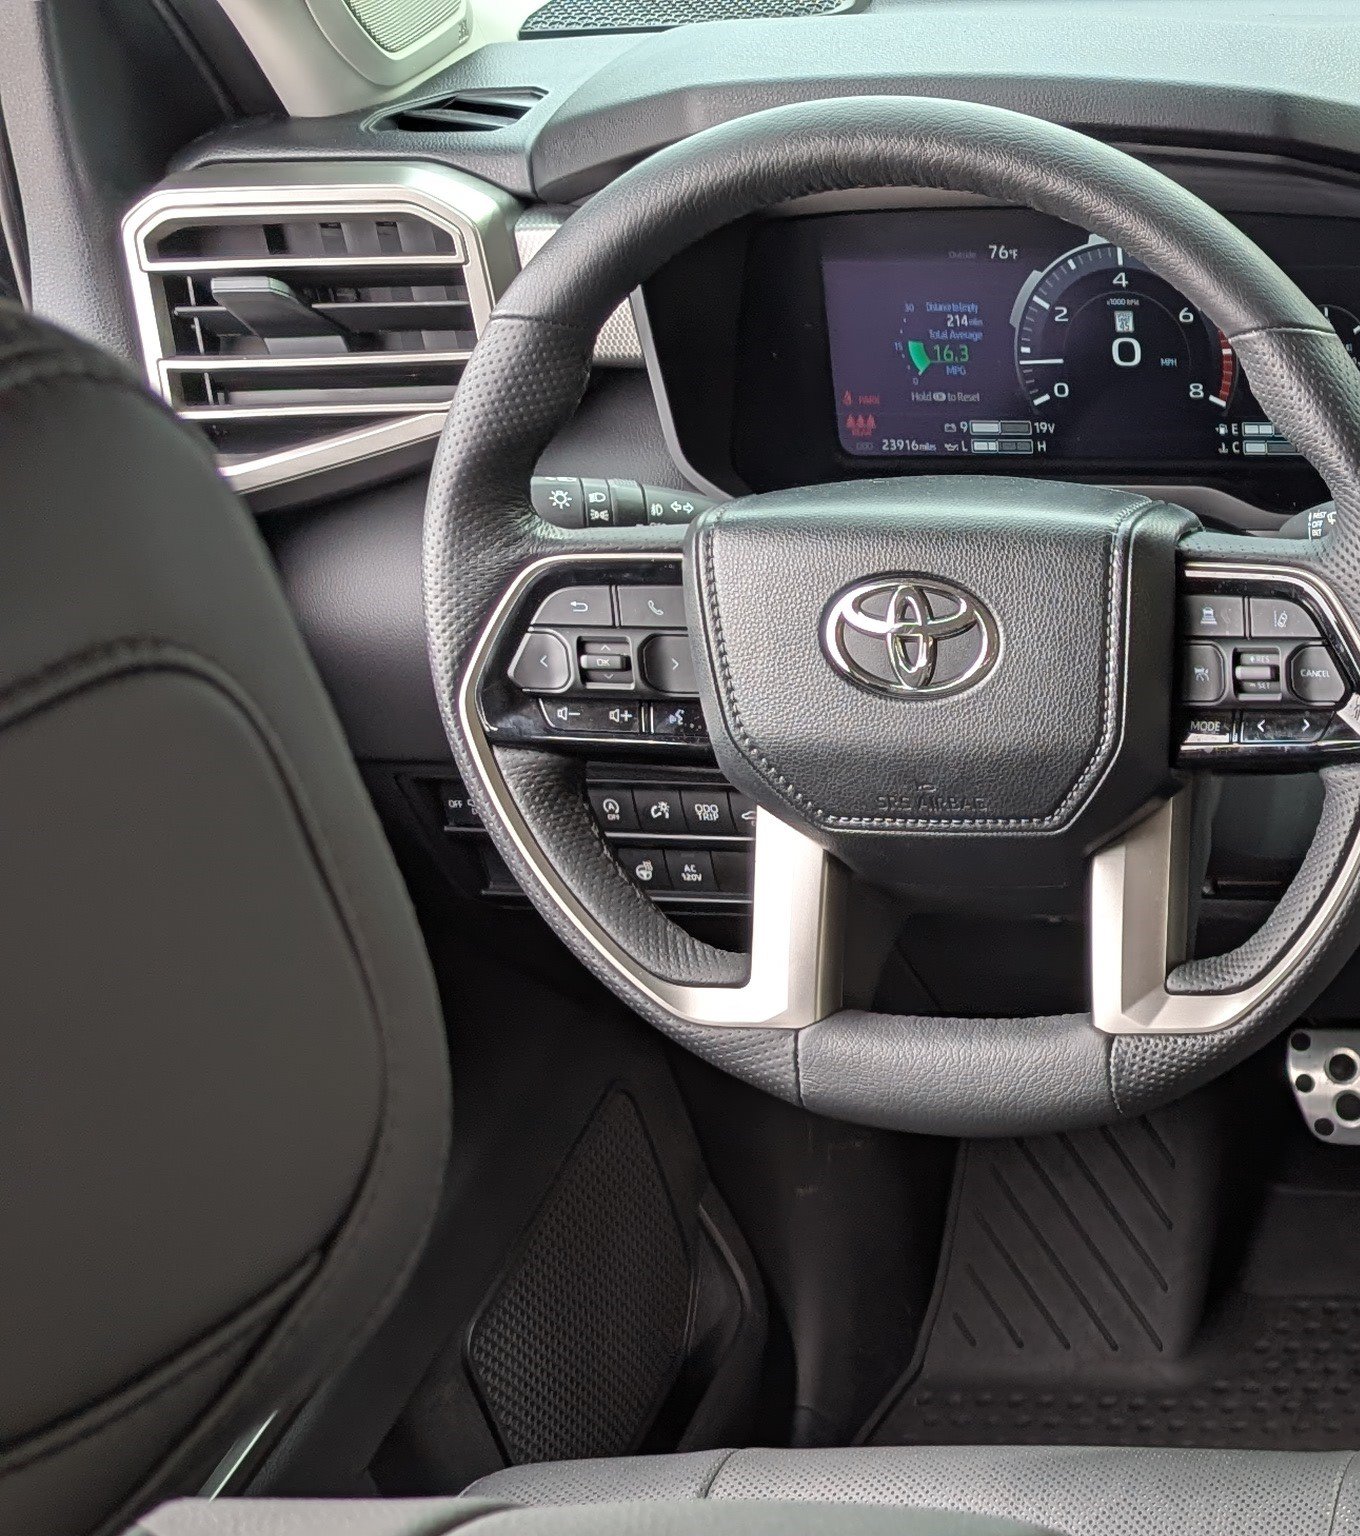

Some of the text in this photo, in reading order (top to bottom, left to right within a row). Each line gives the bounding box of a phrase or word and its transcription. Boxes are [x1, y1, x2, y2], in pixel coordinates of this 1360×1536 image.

[1112, 272, 1129, 288] 4
[1054, 306, 1069, 322] 2
[1179, 307, 1195, 323] 6
[947, 314, 968, 327] 214
[933, 343, 970, 363] 16.3
[1111, 337, 1142, 367] 0
[1160, 358, 1178, 368] MPH
[1054, 382, 1069, 398] 0
[1189, 383, 1205, 399] 8
[960, 421, 968, 434] 9
[1033, 422, 1056, 434] 19V
[1231, 423, 1240, 435] E
[881, 439, 919, 451] 23916
[961, 440, 969, 452] L
[1036, 440, 1048, 452] H
[1232, 441, 1241, 453] C
[596, 658, 611, 667] OK
[1300, 669, 1330, 679] CANCEL
[1190, 721, 1221, 732] MODE
[448, 799, 463, 809] OFF
[694, 803, 719, 814] ODO
[697, 812, 720, 822] TRIP
[684, 864, 697, 873] AC
[681, 873, 702, 882] 120V
